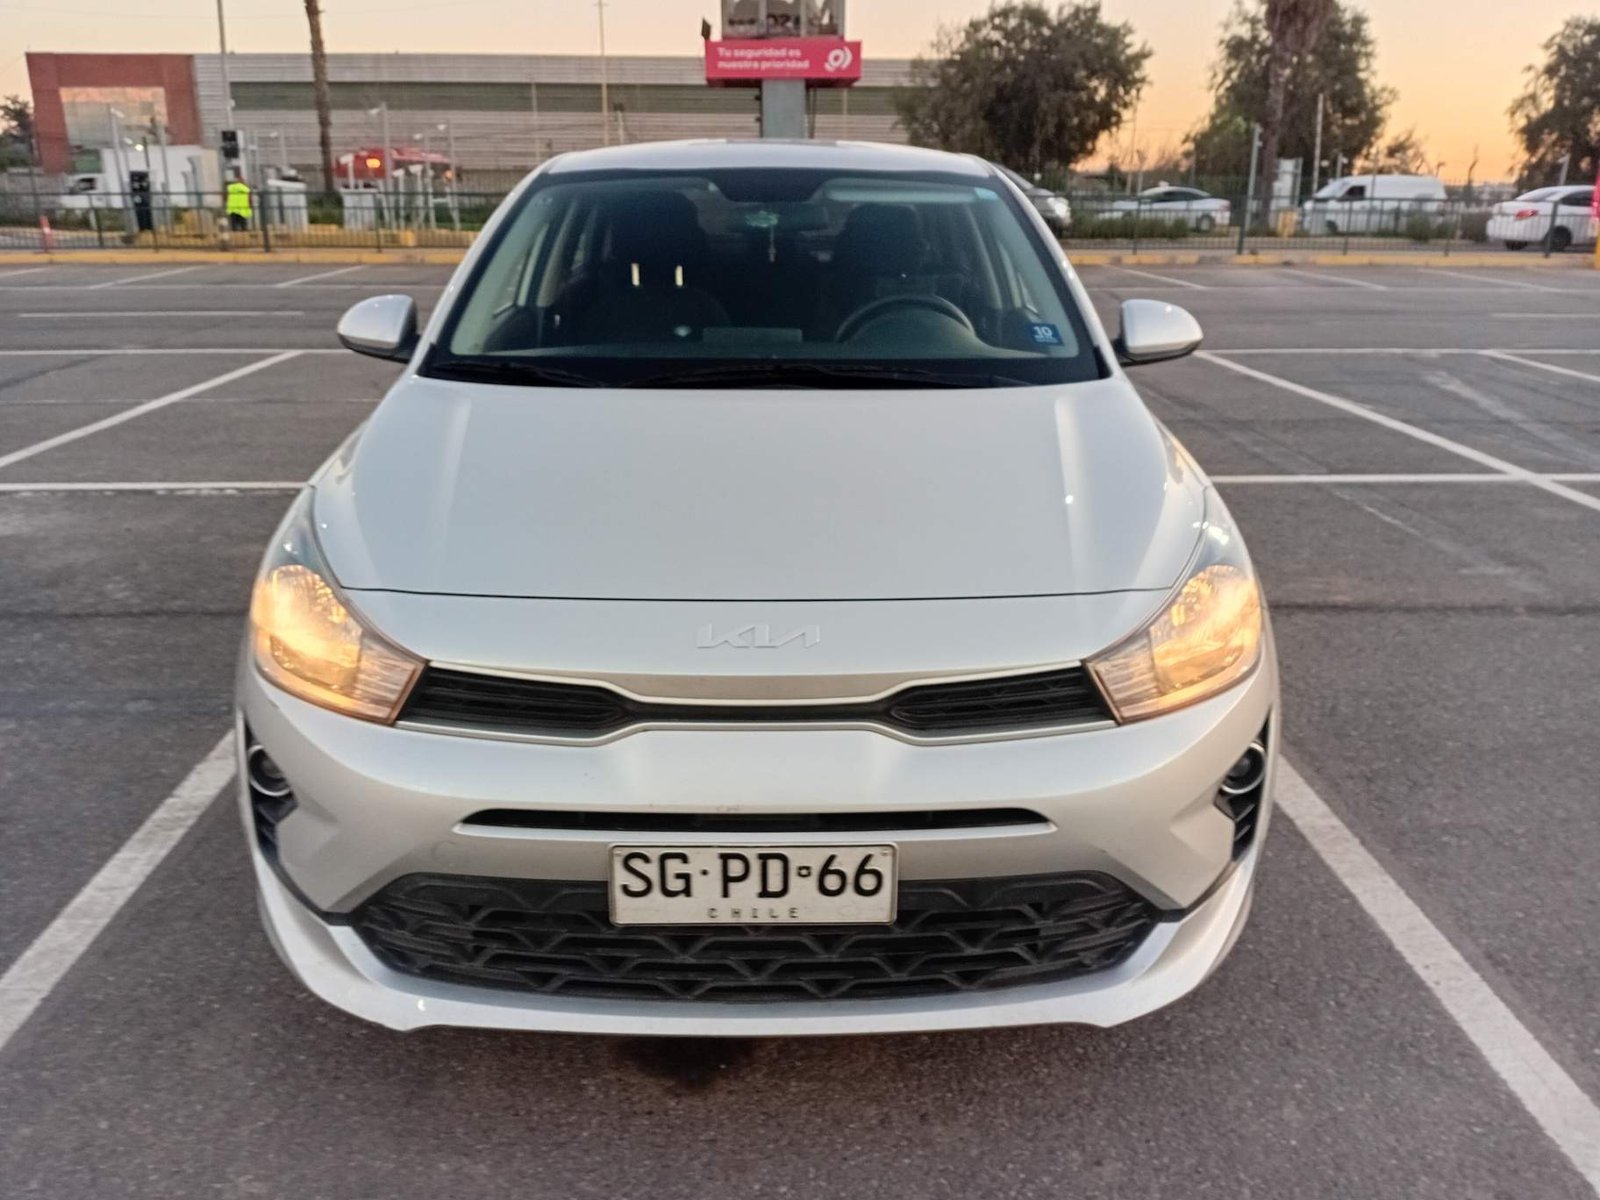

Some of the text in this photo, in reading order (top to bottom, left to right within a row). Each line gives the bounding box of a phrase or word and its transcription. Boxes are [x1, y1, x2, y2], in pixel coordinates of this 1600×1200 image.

[717, 47, 801, 60] Tu seguridad es
[717, 59, 810, 71] nuestra prioridad
[695, 623, 821, 649] KIA
[707, 907, 799, 919] CHILE
